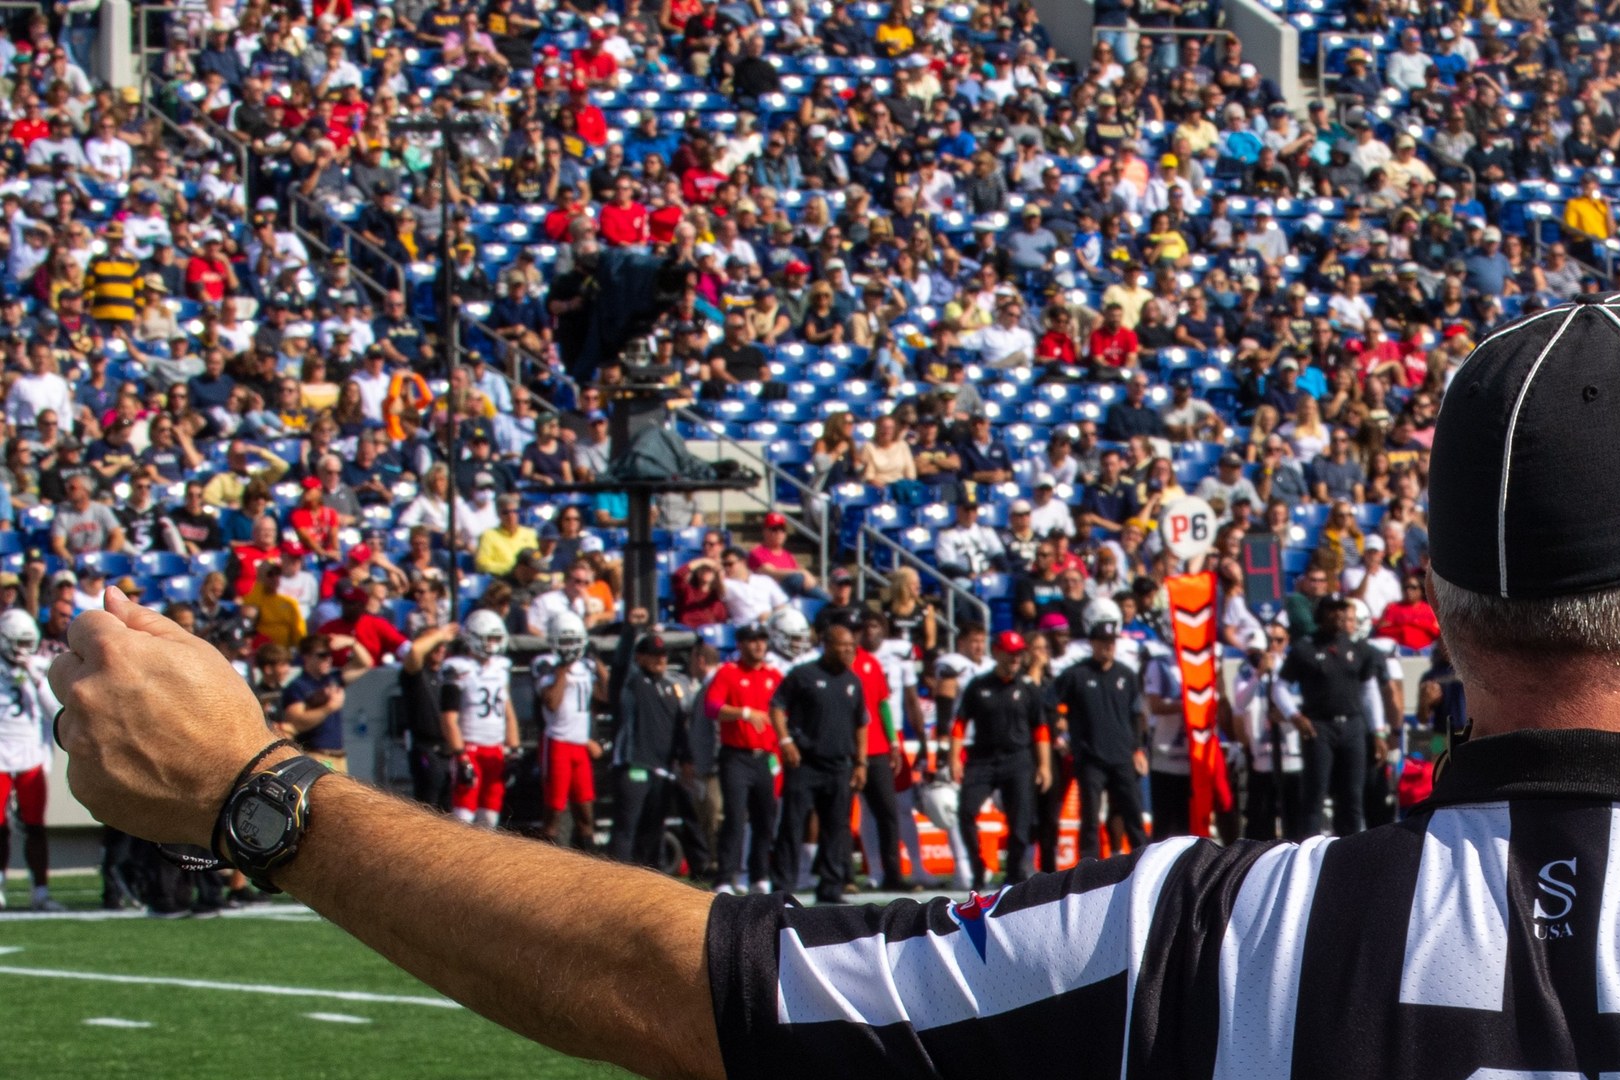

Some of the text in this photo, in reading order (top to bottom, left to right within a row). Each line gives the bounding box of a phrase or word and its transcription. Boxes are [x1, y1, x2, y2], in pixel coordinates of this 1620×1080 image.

[1171, 513, 1208, 543] P6
[1244, 543, 1282, 600] 4
[1532, 856, 1577, 919] S
[1533, 922, 1574, 941] USA
